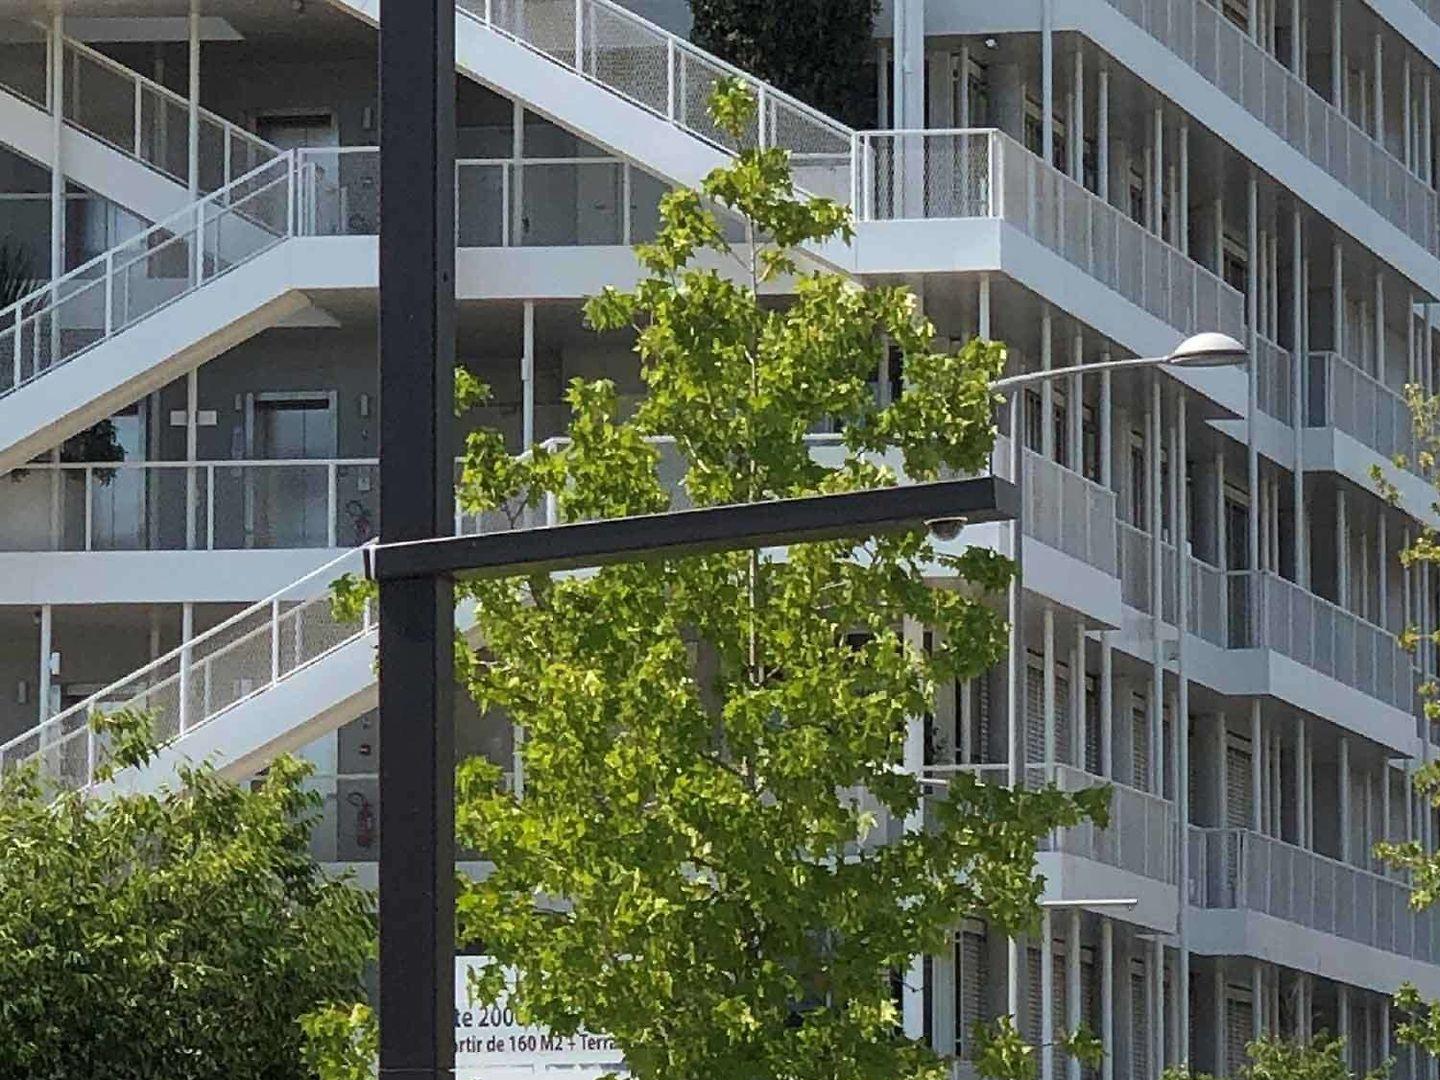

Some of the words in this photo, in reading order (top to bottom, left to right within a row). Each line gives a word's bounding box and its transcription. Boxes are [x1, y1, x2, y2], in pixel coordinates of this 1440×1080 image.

[487, 1035, 505, 1052] de
[508, 1035, 536, 1052] 160
[540, 1034, 563, 1051] M2
